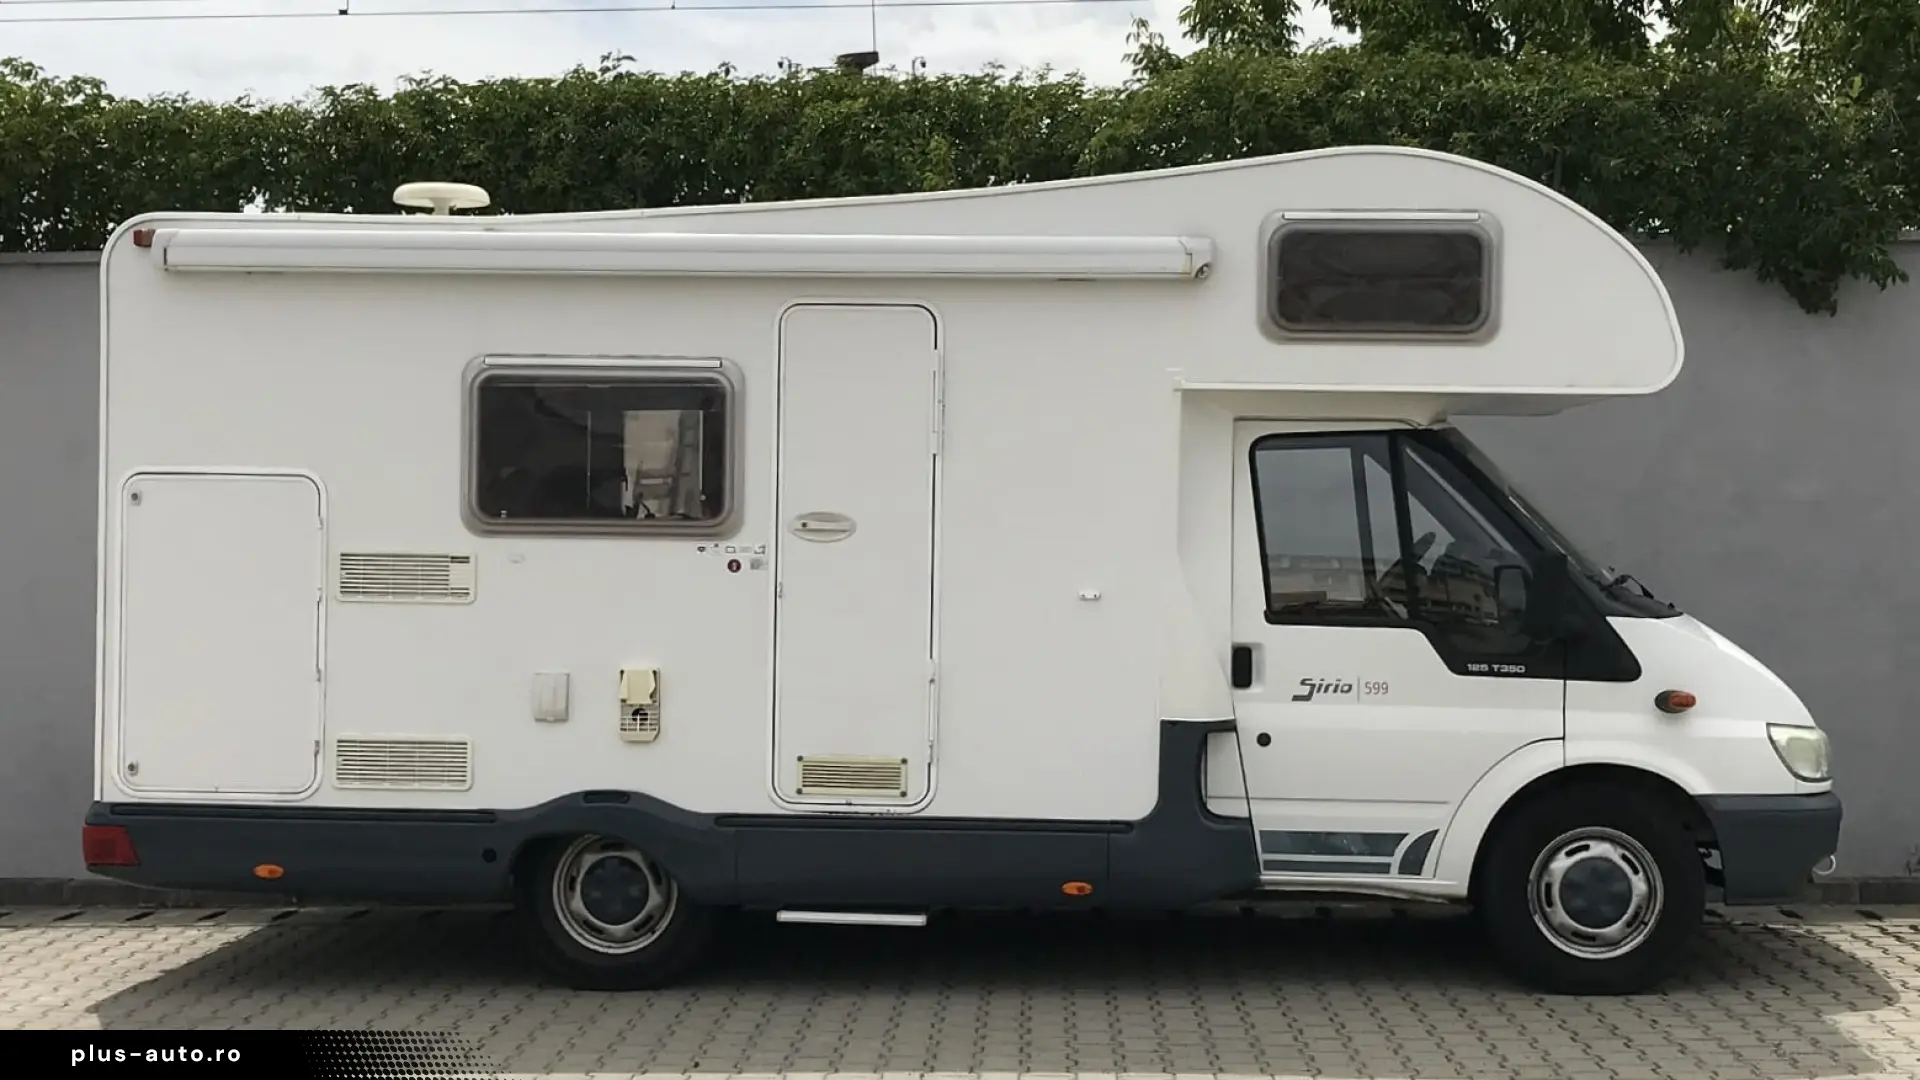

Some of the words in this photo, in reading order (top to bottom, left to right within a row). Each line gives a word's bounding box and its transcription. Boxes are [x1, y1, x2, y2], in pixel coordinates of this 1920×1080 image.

[1491, 664, 1526, 673] T350
[1291, 678, 1353, 702] Sirio
[1364, 681, 1389, 695] 599
